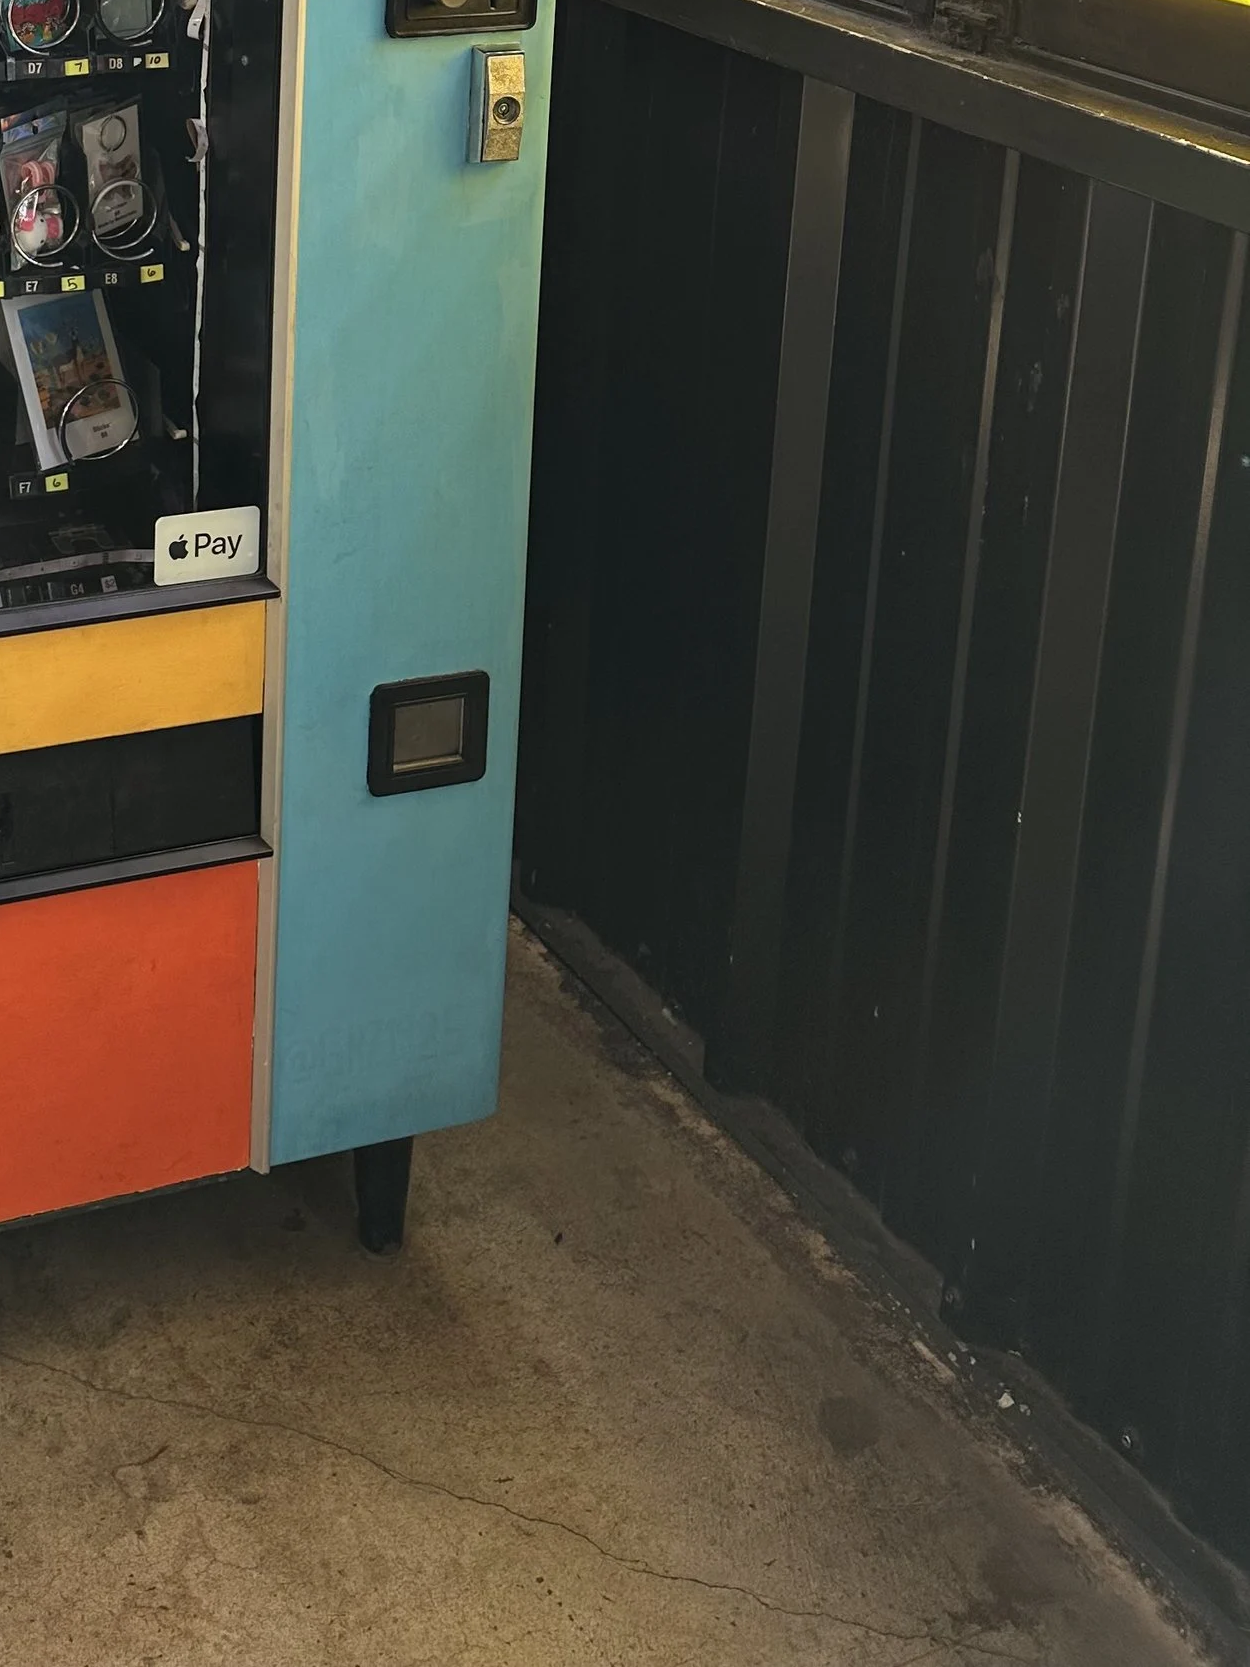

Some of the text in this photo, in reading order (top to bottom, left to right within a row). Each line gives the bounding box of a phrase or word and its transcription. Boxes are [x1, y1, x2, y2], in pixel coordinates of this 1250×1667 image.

[108, 58, 124, 70] D8
[149, 56, 161, 65] 10
[27, 62, 43, 74] D7
[74, 63, 83, 72] 7
[105, 272, 118, 284] E8
[146, 267, 156, 277] 6
[25, 280, 39, 292] E7
[66, 278, 78, 290] 5
[18, 481, 31, 494] F7
[51, 478, 62, 488] 6
[193, 532, 243, 561] Pay
[104, 578, 116, 589] $2
[70, 584, 85, 596] G4
